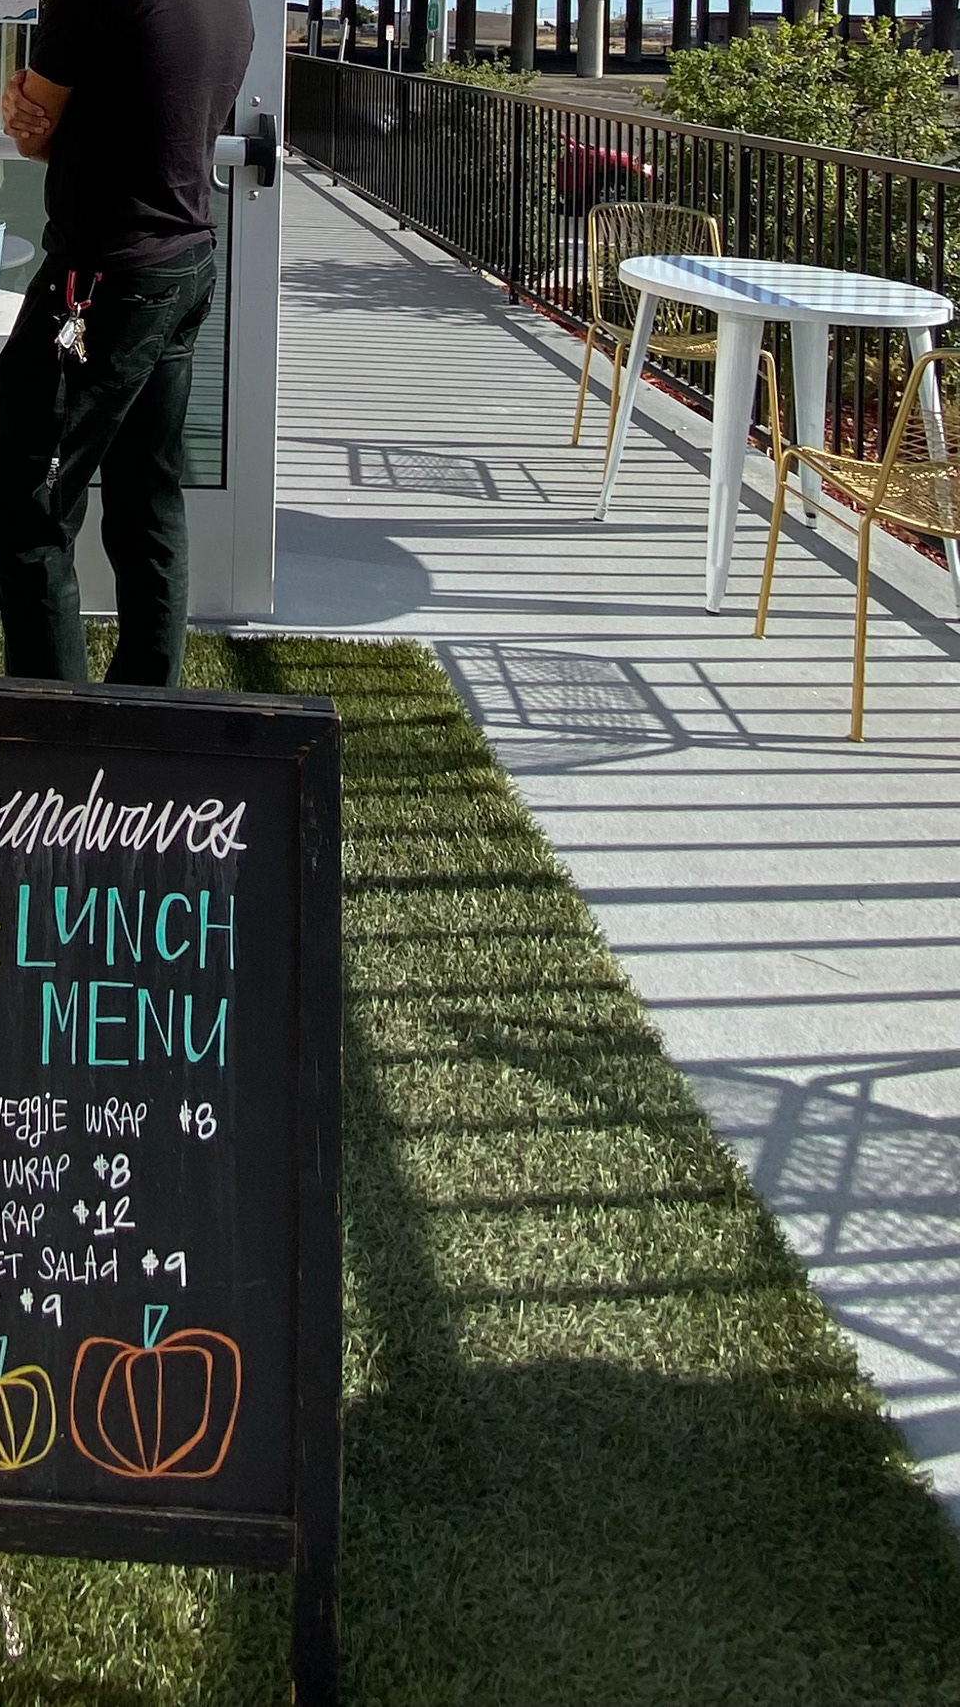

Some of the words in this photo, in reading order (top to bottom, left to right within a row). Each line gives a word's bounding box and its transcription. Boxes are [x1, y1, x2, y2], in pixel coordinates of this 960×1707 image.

[17, 885, 234, 970] LUNCH
[42, 982, 227, 1066] MENU
[86, 1097, 147, 1138] WRAP
[179, 1100, 216, 1140] $8
[3, 1154, 70, 1195] WRAP
[93, 1154, 130, 1189] $8
[73, 1196, 135, 1236] $12
[142, 1249, 186, 1287] $9
